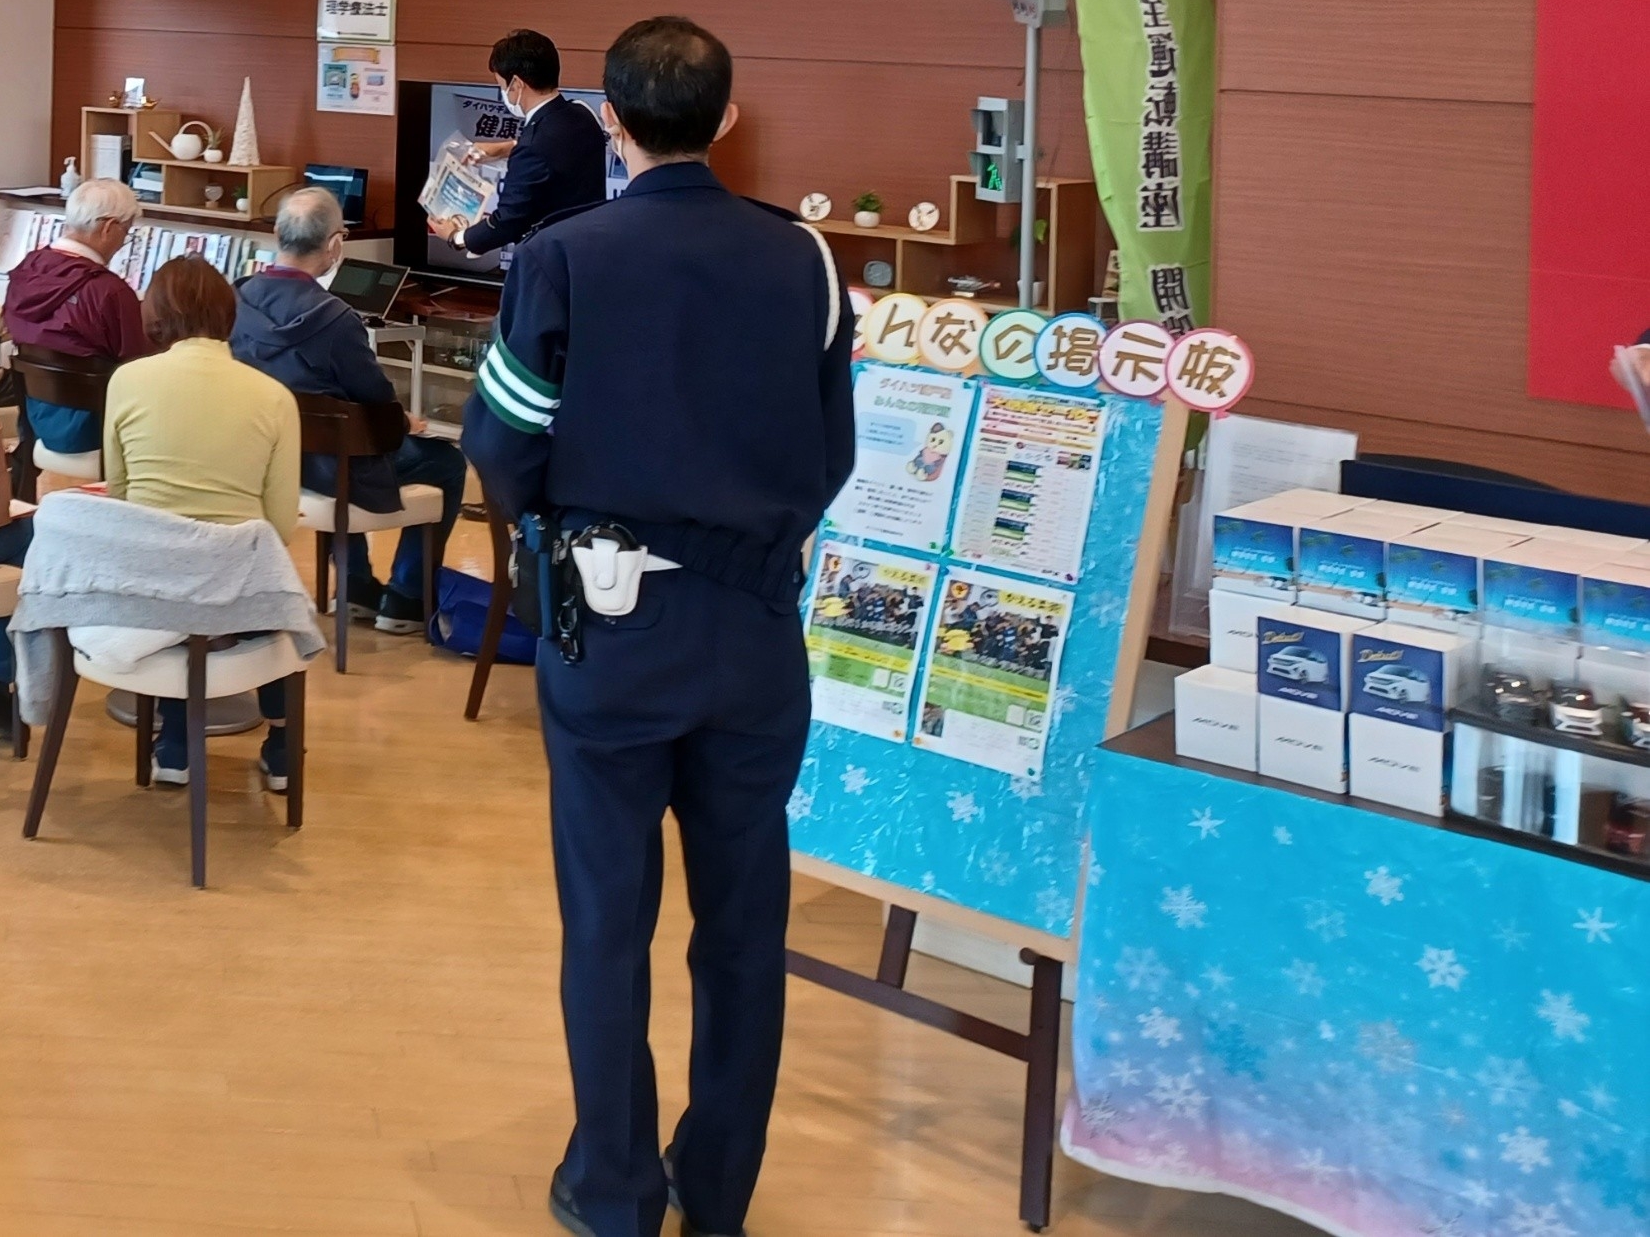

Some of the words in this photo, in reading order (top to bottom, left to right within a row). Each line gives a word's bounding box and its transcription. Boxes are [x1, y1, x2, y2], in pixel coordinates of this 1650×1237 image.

[853, 303, 1241, 399] んなの掲示板
